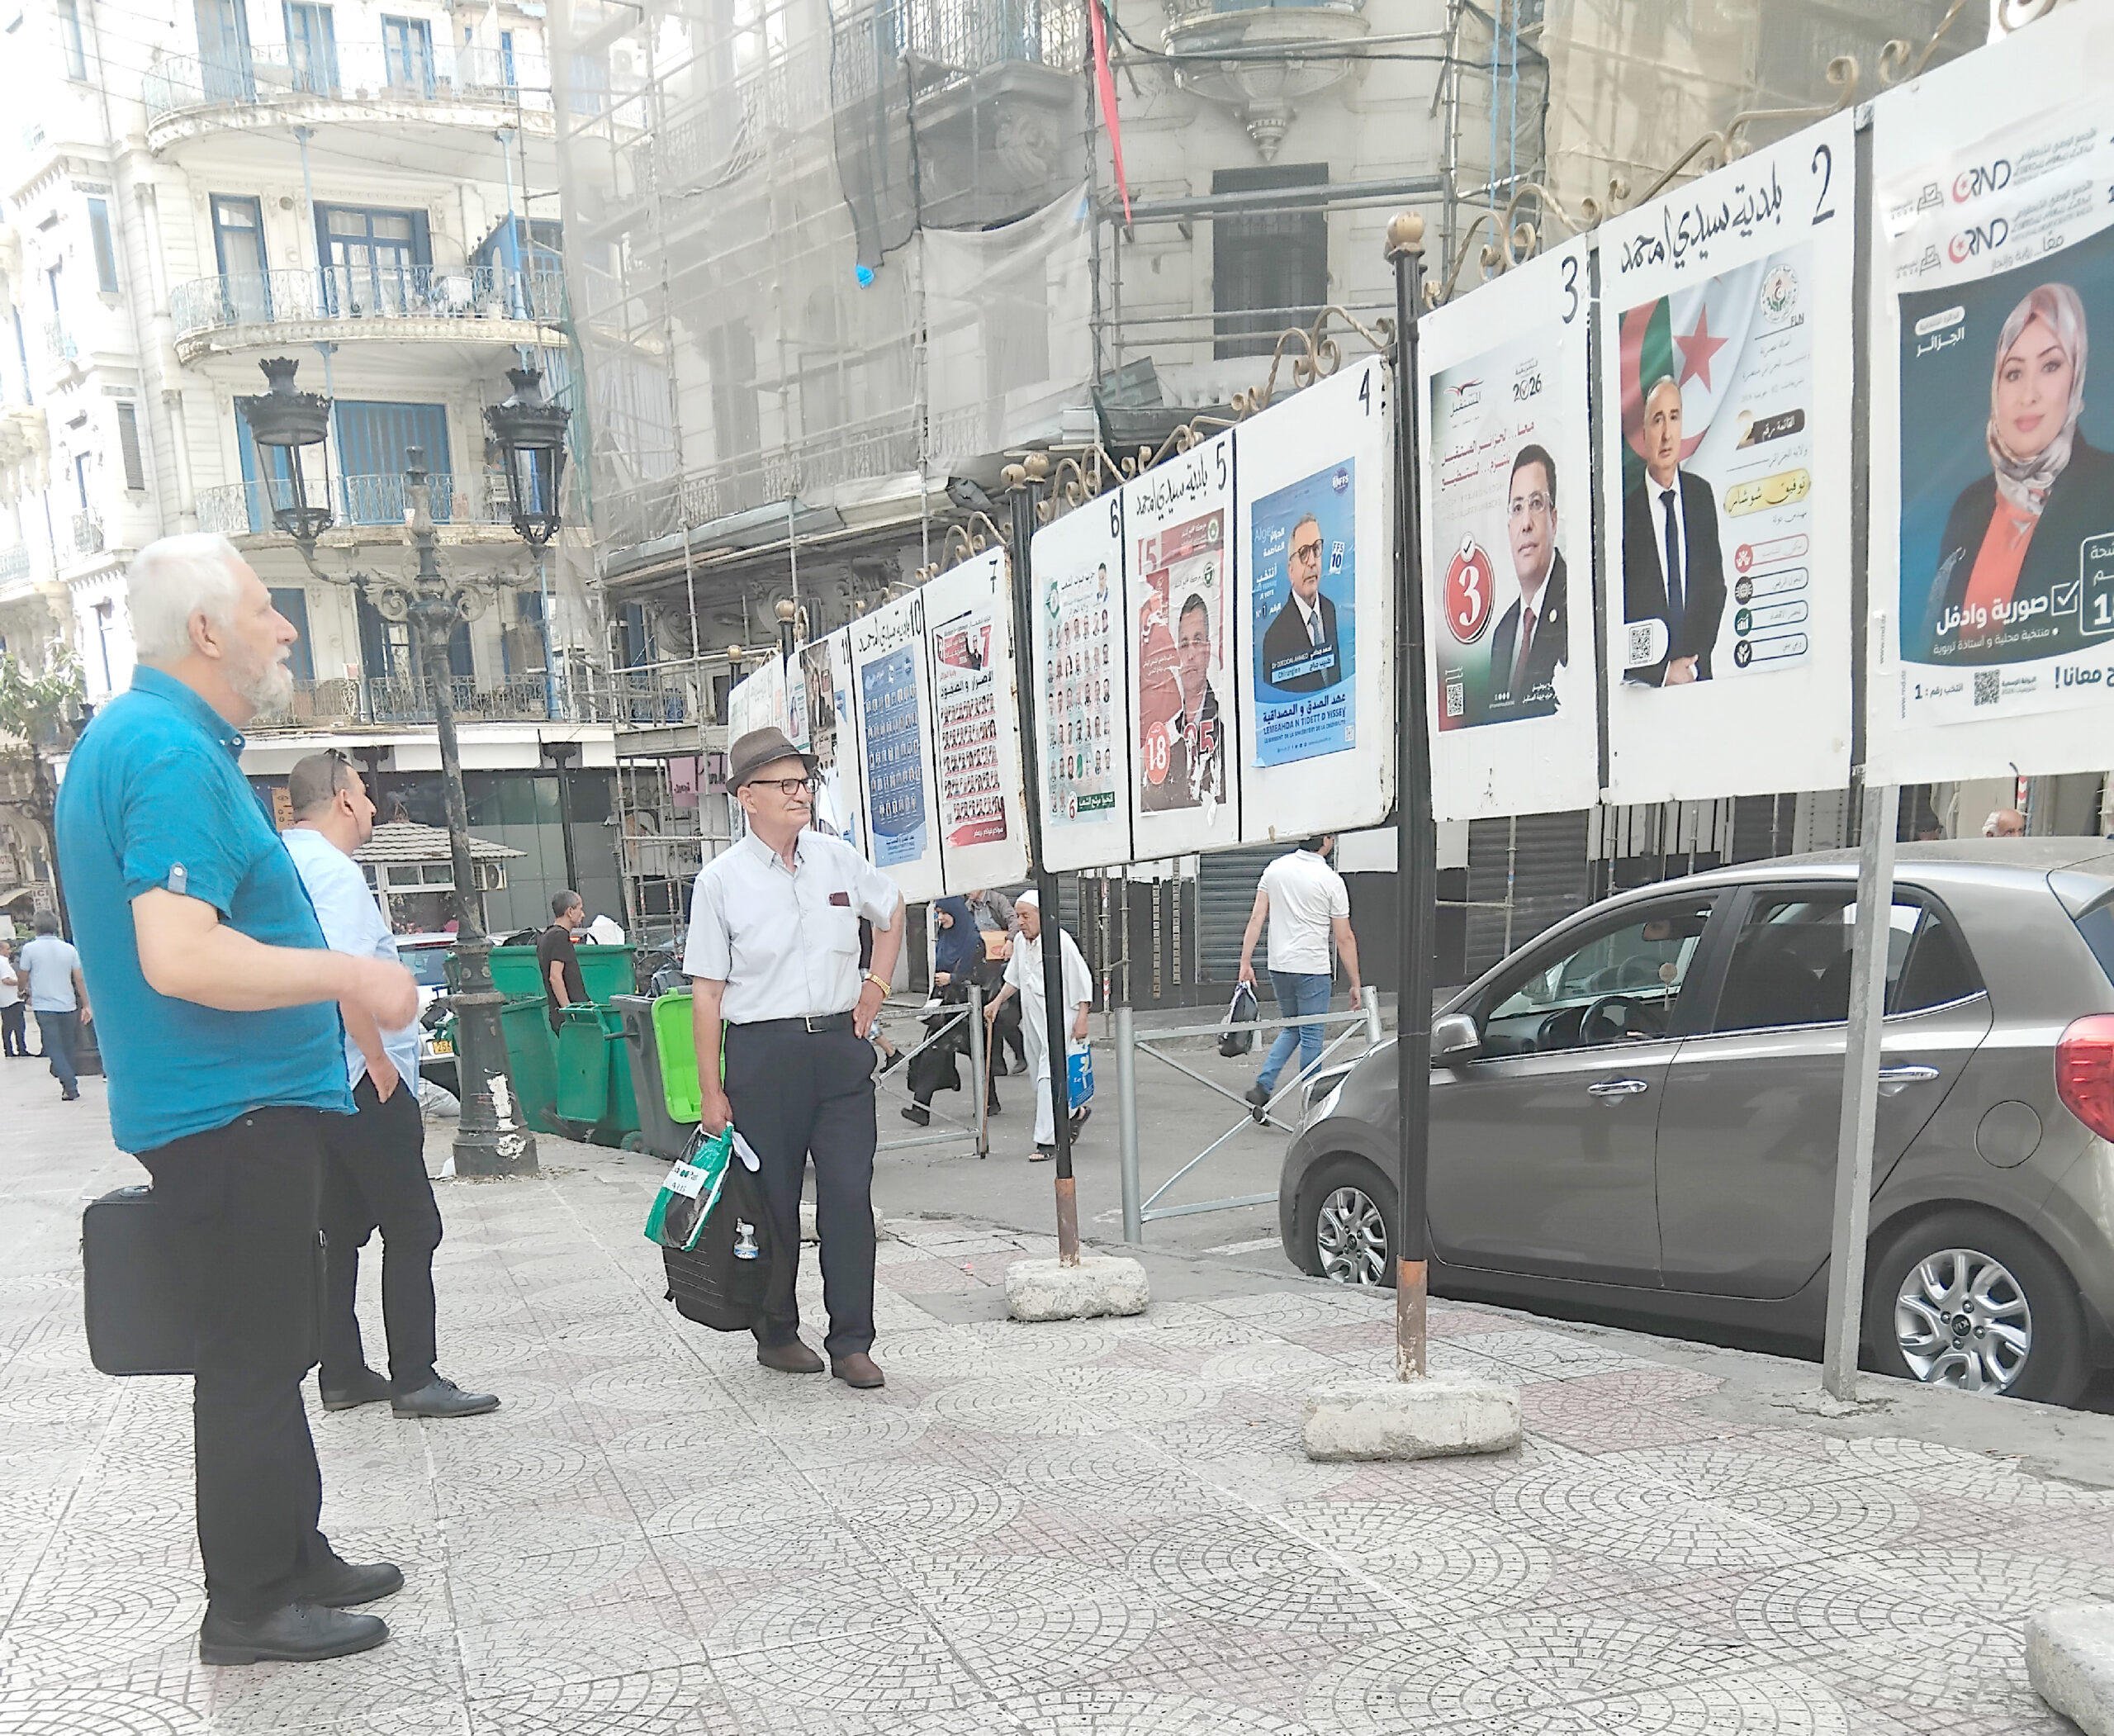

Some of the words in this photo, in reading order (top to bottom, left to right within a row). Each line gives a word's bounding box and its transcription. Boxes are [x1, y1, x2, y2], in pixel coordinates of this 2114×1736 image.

[1811, 144, 1836, 226] 2
[1969, 159, 2012, 197] RND
[1732, 159, 1784, 237] بلدية
[1670, 201, 1731, 270] سيدي
[1964, 217, 2008, 255] RND
[1561, 255, 1579, 325] 3
[1790, 313, 1804, 326] FLN
[1916, 326, 1965, 358] الجزائر
[1358, 368, 1370, 417] 4
[1450, 391, 1481, 418] المستقبل
[1186, 453, 1208, 501] بلدية
[1216, 441, 1227, 491] 5
[1765, 476, 1806, 505] توفيق
[1110, 498, 1120, 538] 6
[1263, 541, 1285, 557] العاصمة
[1331, 553, 1342, 568] 10
[1332, 542, 1344, 553] FFS
[988, 559, 998, 595] 7
[1458, 566, 1481, 627] 3
[1991, 595, 2049, 626] صورية
[910, 598, 922, 637] 10
[1936, 603, 1988, 636] وادفل
[1933, 640, 1956, 655] تربوية
[1957, 635, 1984, 651] أستاذة
[1986, 638, 1993, 648] و
[1994, 633, 2020, 647] محلية
[2021, 626, 2050, 642] منتخبة
[841, 638, 850, 666] 11
[1263, 703, 1298, 725] المصداقية
[1300, 704, 1305, 717] و
[1306, 695, 1330, 714] الصدق
[1330, 693, 1346, 705] عهد
[1147, 734, 1168, 771] 18
[1069, 799, 1076, 819] 6
